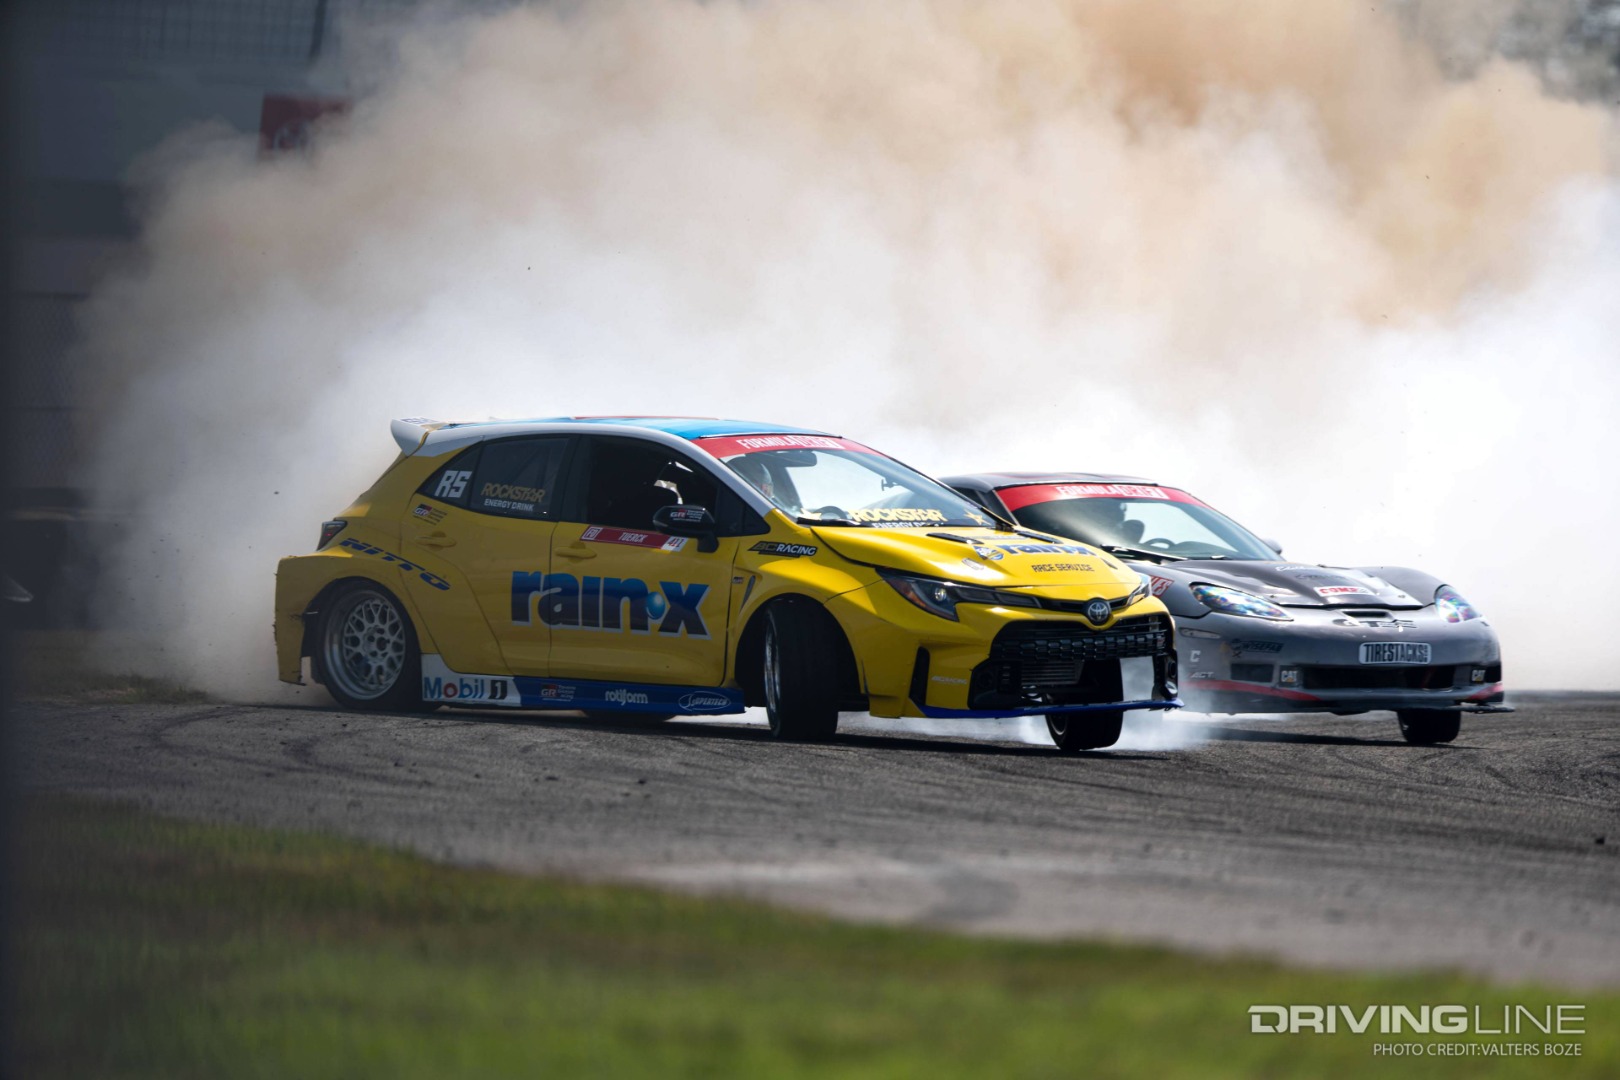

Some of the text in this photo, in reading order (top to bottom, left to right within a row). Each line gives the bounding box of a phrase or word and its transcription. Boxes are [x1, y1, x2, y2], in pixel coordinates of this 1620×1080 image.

[434, 470, 473, 498] RS
[480, 483, 546, 503] ROCKSTAR
[484, 499, 535, 512] ENERGY DRINK
[852, 509, 948, 522] ROCKSTAR
[618, 531, 648, 543] TUERCK
[776, 544, 816, 556] RACING
[339, 537, 451, 591] NITTO
[1031, 563, 1095, 573] RACE SERVICE
[1363, 643, 1424, 663] TIRESTACKS
[1281, 670, 1298, 683] CAT
[1472, 669, 1486, 682] CAT
[424, 677, 484, 699] Mobil
[541, 688, 556, 697] GR
[604, 689, 649, 706] rotiform
